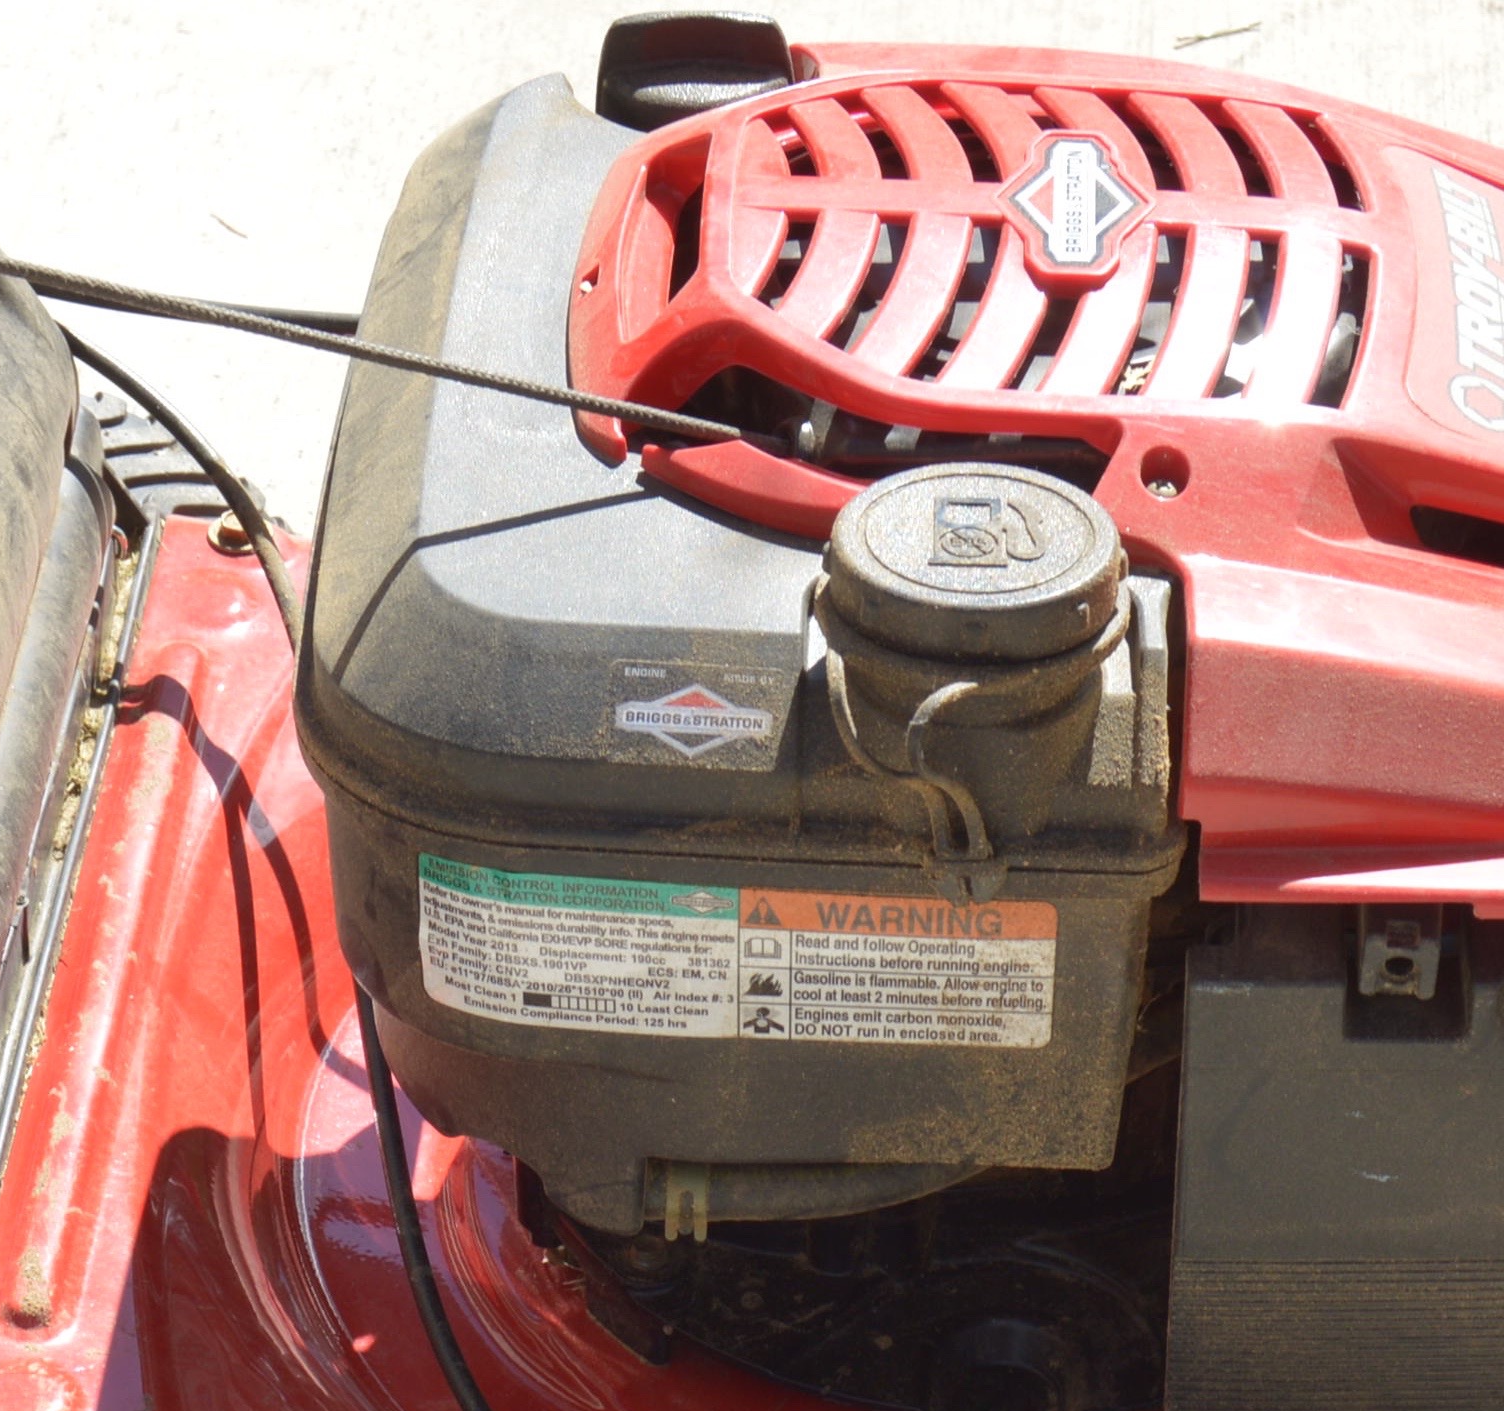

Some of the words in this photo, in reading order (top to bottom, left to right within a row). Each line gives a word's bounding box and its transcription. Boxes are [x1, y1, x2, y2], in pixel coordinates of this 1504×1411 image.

[425, 868, 469, 891] BRIGGS
[487, 887, 559, 903] STRATTON
[429, 858, 488, 883] EMISSION
[493, 876, 559, 891] CONTROL
[563, 883, 658, 898] INFORMATION
[424, 881, 446, 896] Refer
[450, 889, 459, 901] to
[462, 897, 502, 912] owner's
[505, 906, 544, 917] manual
[547, 908, 561, 919] for
[566, 911, 635, 924] maintenance
[638, 918, 673, 928] specs,
[424, 896, 484, 922] adjustments,
[488, 913, 495, 923] &
[498, 918, 553, 931] emissions
[556, 924, 607, 936] durability
[609, 929, 632, 937] info.
[637, 929, 658, 939] This
[661, 933, 699, 943] engine
[701, 935, 734, 943] meets
[815, 900, 1002, 937] WARNING
[424, 906, 442, 921] U.S.
[445, 913, 464, 926] EPA
[467, 922, 485, 934] and
[488, 927, 538, 942] California
[541, 934, 592, 946] EXH/EVP
[594, 938, 628, 948] SORE
[631, 942, 691, 954] regulations
[694, 945, 712, 955] for:
[429, 921, 459, 939] Model
[463, 933, 486, 946] Year
[491, 940, 518, 952] 2013
[539, 946, 626, 963] Displacement:
[632, 954, 666, 965] 190cc
[688, 958, 730, 968] 381362
[795, 934, 832, 949] Read
[834, 936, 858, 950] and
[863, 937, 905, 953] follow
[908, 939, 975, 958] Operating
[428, 933, 447, 946] Exh
[451, 940, 492, 961] Family:
[648, 967, 678, 977] ECS:
[682, 970, 704, 980] EM,
[709, 970, 727, 980] CN
[428, 945, 449, 959] Evp
[452, 952, 492, 973] Family:
[495, 965, 529, 978] CNV2
[794, 951, 875, 967] Instructions
[880, 955, 923, 969] before
[927, 957, 979, 974] running
[983, 959, 1033, 977] engine.
[430, 957, 447, 970] EU:
[654, 992, 672, 1001] Air
[675, 992, 708, 1003] Index
[727, 995, 734, 1003] 3
[445, 975, 471, 991] Most
[474, 985, 506, 1001] Clean
[511, 993, 516, 1002] 1
[621, 1003, 633, 1011] 10
[638, 1004, 670, 1014] Least
[674, 1006, 709, 1016] Clean
[793, 971, 851, 986] Gasoline
[855, 973, 865, 986] is
[869, 973, 940, 990] flammable.
[944, 976, 979, 991] Allow
[983, 979, 1027, 996] engine
[1030, 980, 1043, 992] to
[464, 995, 517, 1015] Emission
[521, 1007, 592, 1022] Compliance
[596, 1015, 639, 1026] Period:
[645, 1018, 664, 1026] 125
[668, 1020, 687, 1028] hrs
[793, 987, 821, 1001] cool
[825, 989, 836, 1001] at
[841, 989, 871, 1003] least
[874, 991, 882, 1003] 2
[886, 991, 937, 1005] minutes
[941, 993, 982, 1007] before
[986, 995, 1046, 1011] refueling.
[794, 1007, 848, 1023] Engines
[852, 1009, 882, 1023] emit
[886, 1010, 932, 1025] carbon
[794, 1023, 817, 1036] DO
[821, 1024, 852, 1037] NOT
[857, 1026, 878, 1038] run
[883, 1026, 895, 1038] in
[899, 1027, 965, 1041] enclosed
[968, 1030, 1001, 1043] area.
